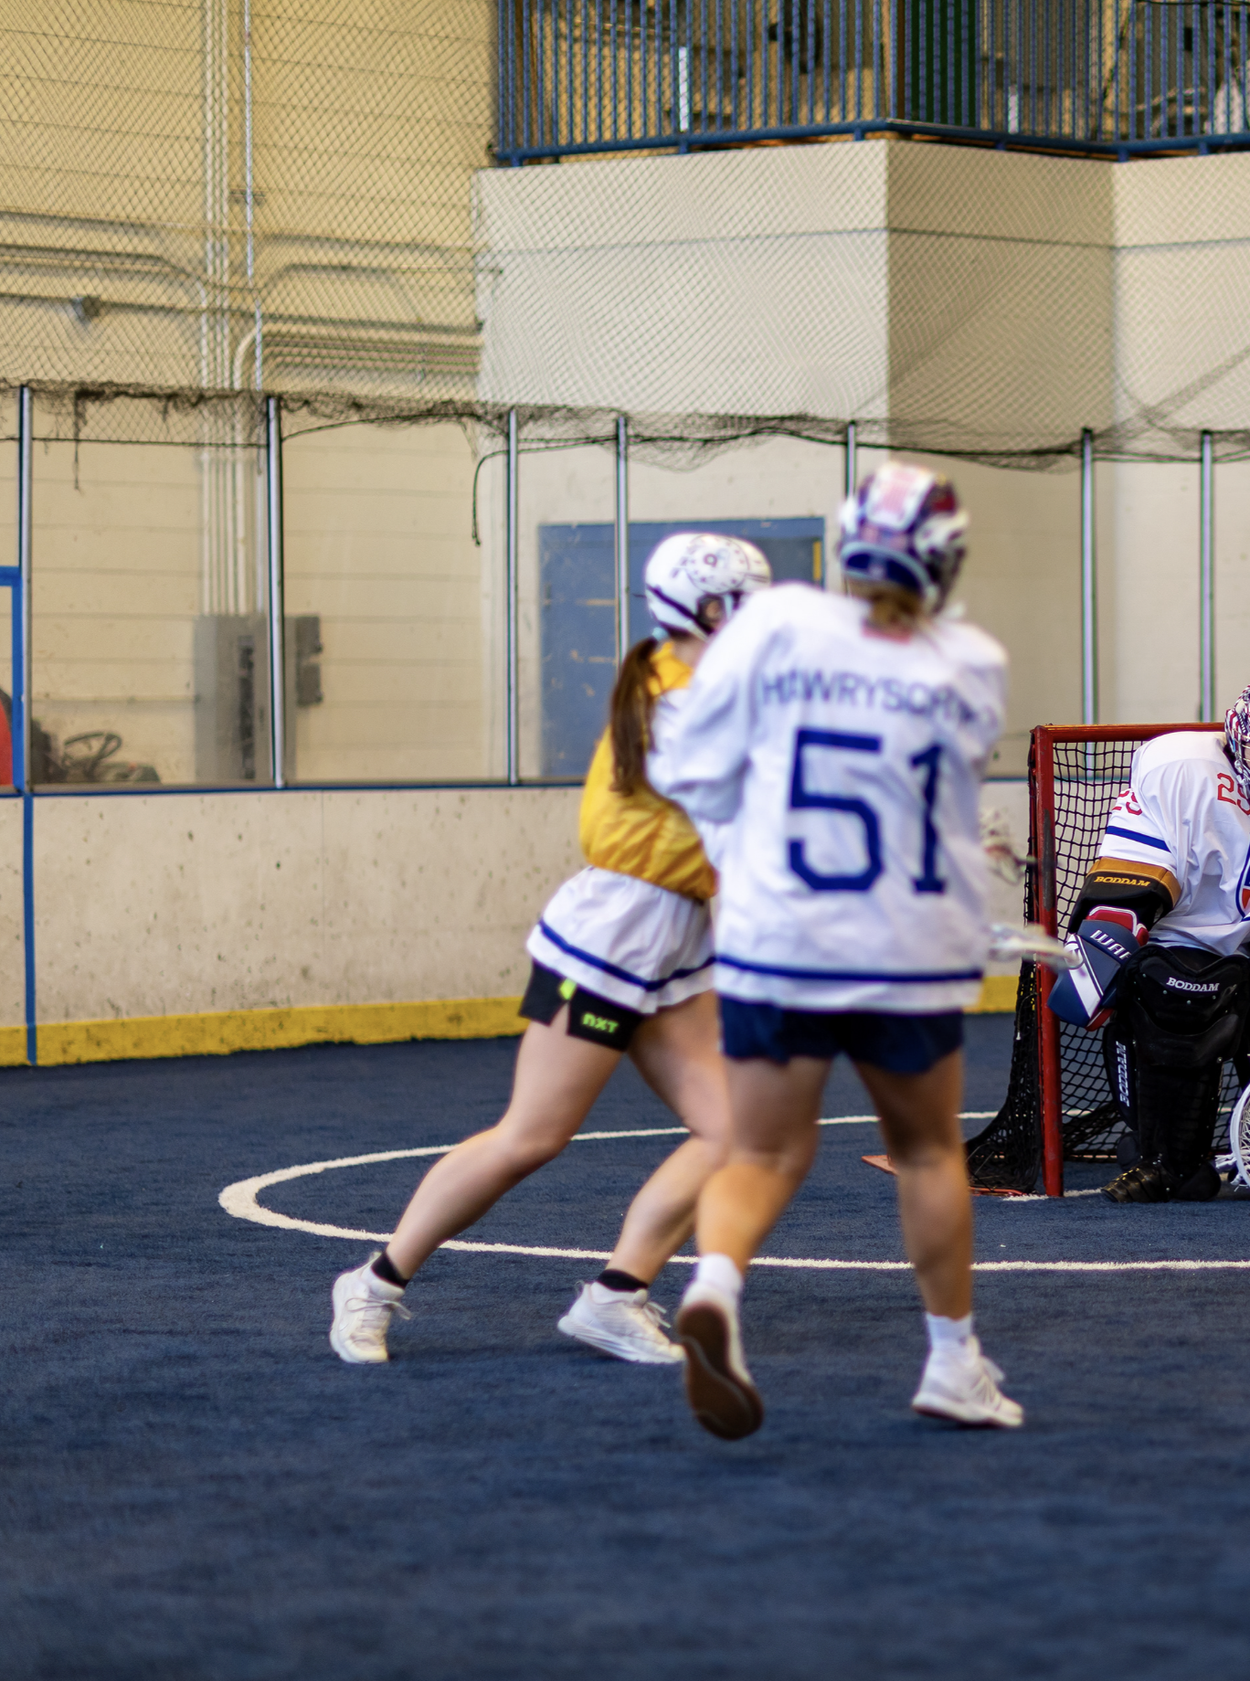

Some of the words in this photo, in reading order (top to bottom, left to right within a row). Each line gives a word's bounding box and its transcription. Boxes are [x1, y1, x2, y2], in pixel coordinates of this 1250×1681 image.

[786, 726, 947, 895] 51
[1093, 876, 1151, 887] BODDAM
[1166, 976, 1220, 992] BODDAM
[1115, 1040, 1130, 1107] BODDAM
